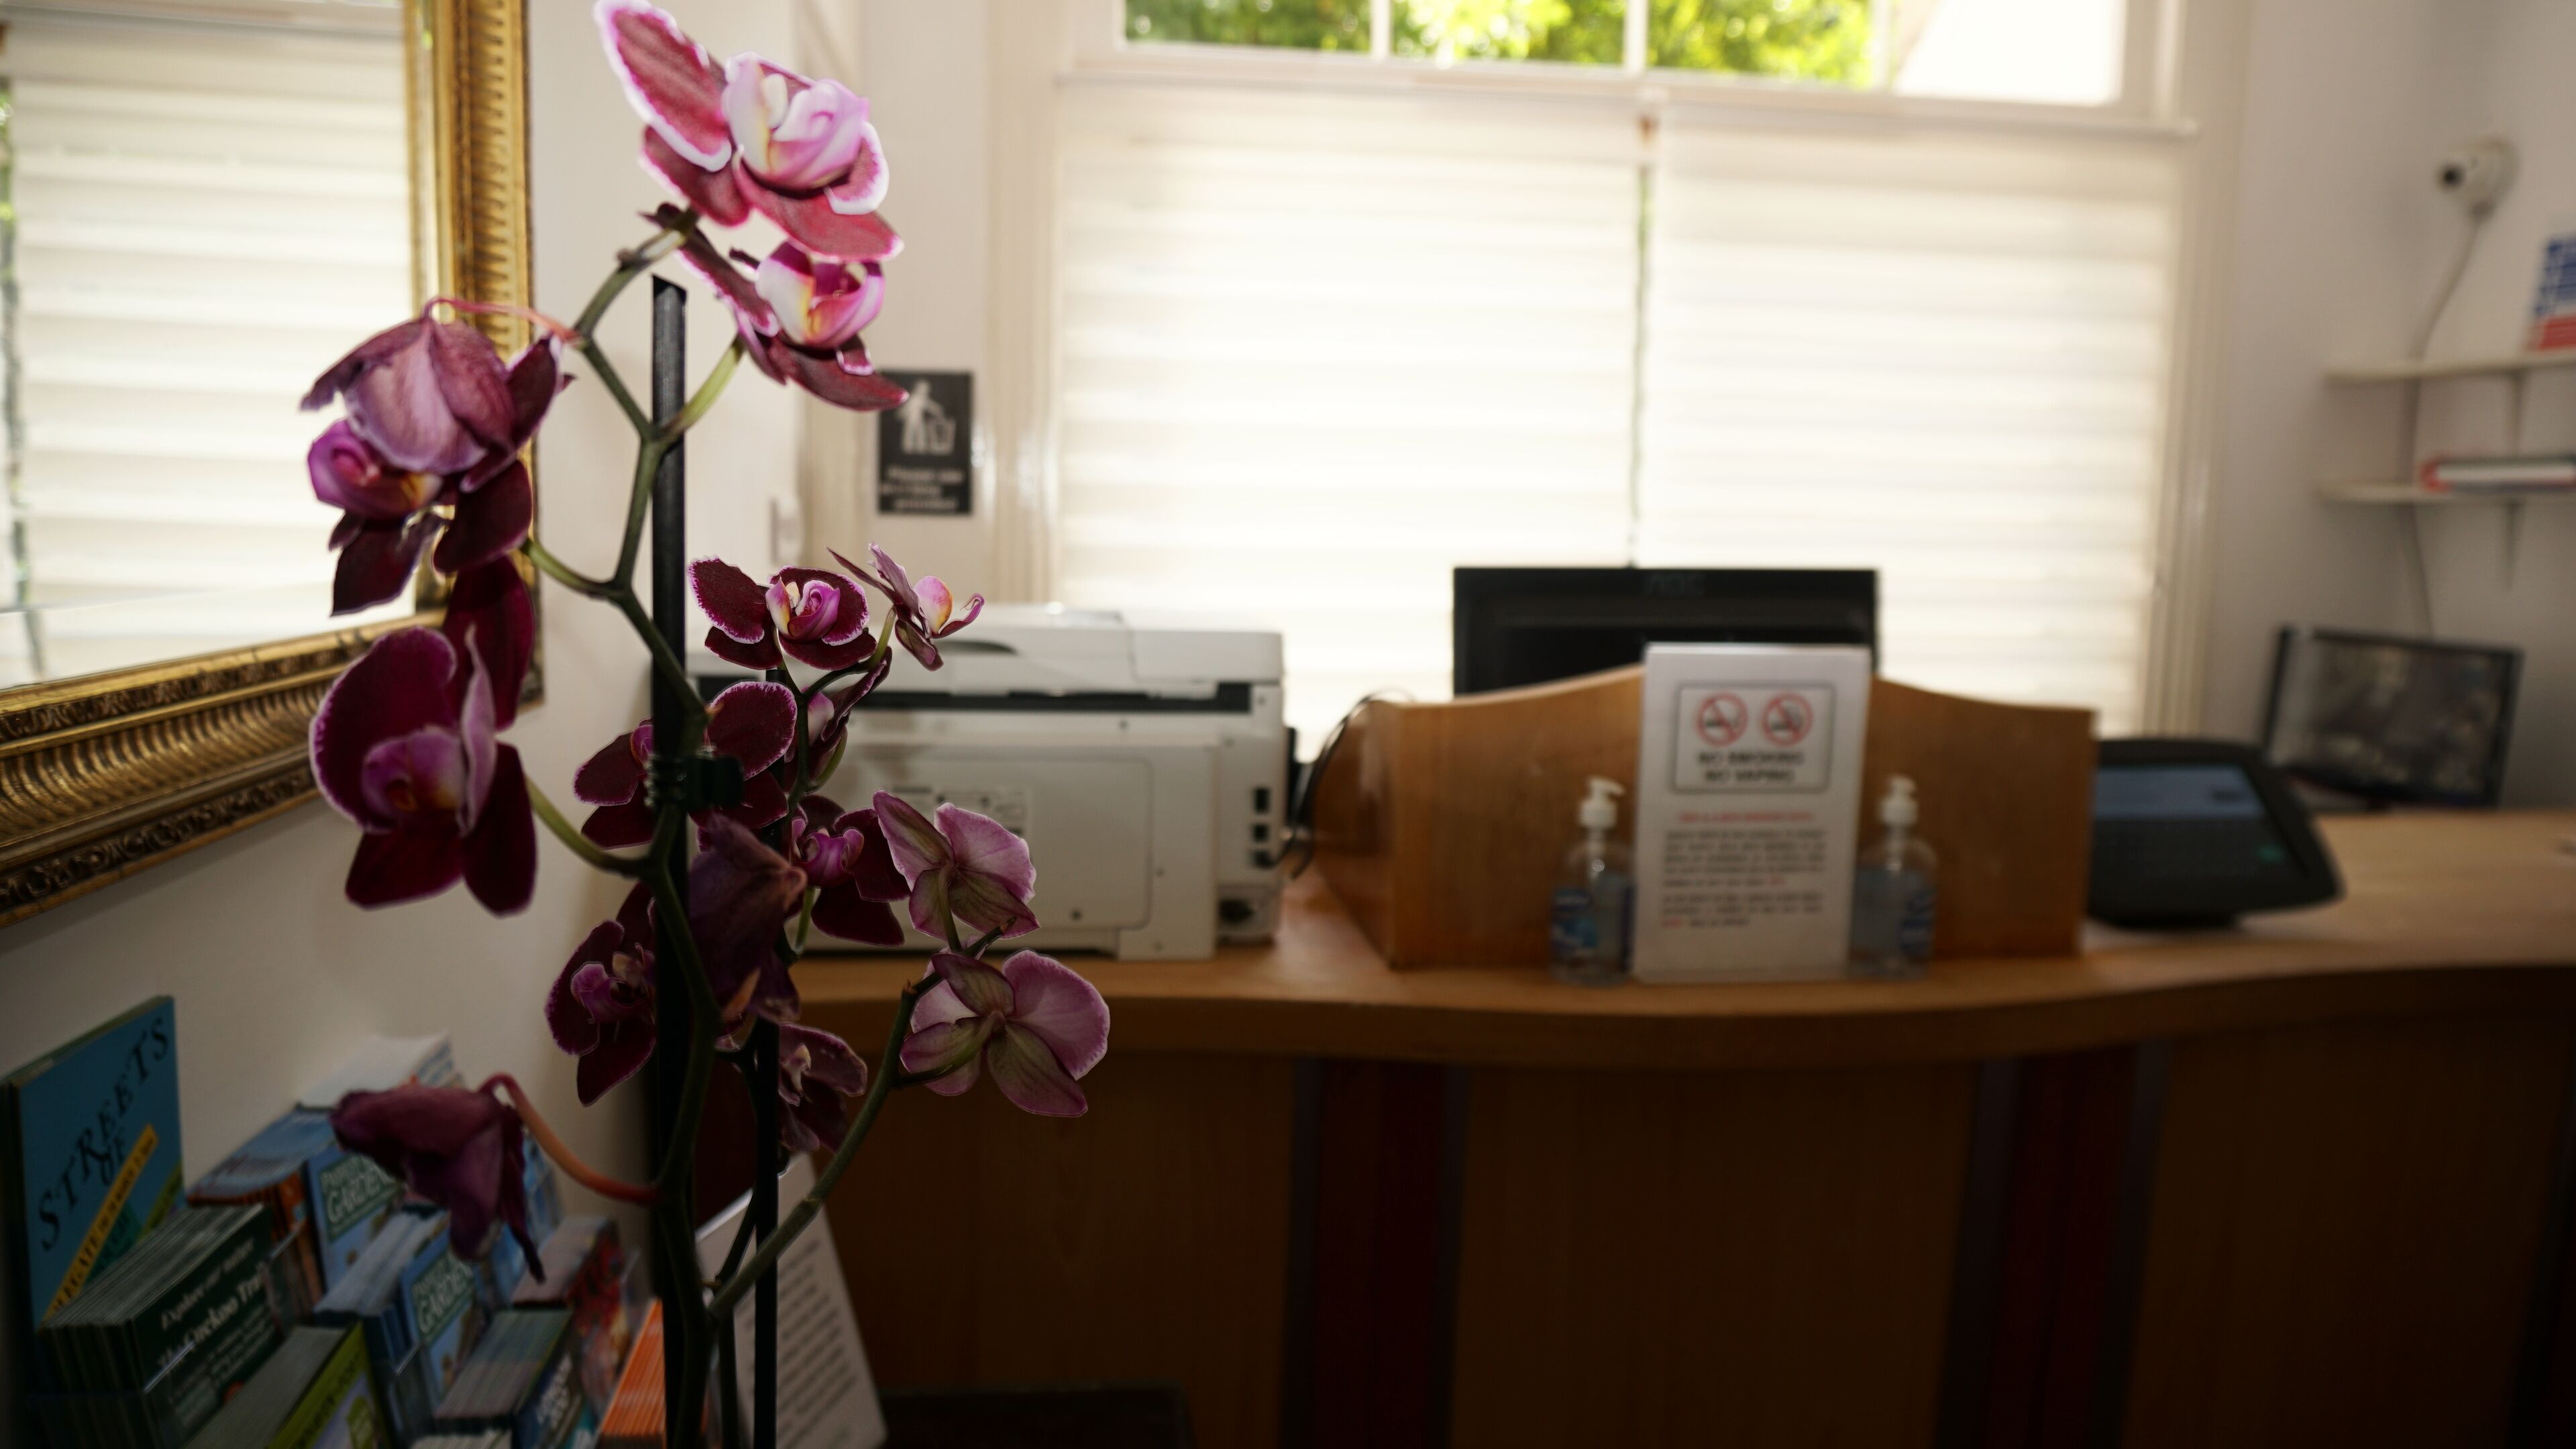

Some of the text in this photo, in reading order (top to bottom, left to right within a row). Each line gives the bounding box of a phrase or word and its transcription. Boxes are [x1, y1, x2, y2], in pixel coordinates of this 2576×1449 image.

[1699, 750, 1807, 765] NO SMOKING
[38, 1015, 171, 1253] STREETS
